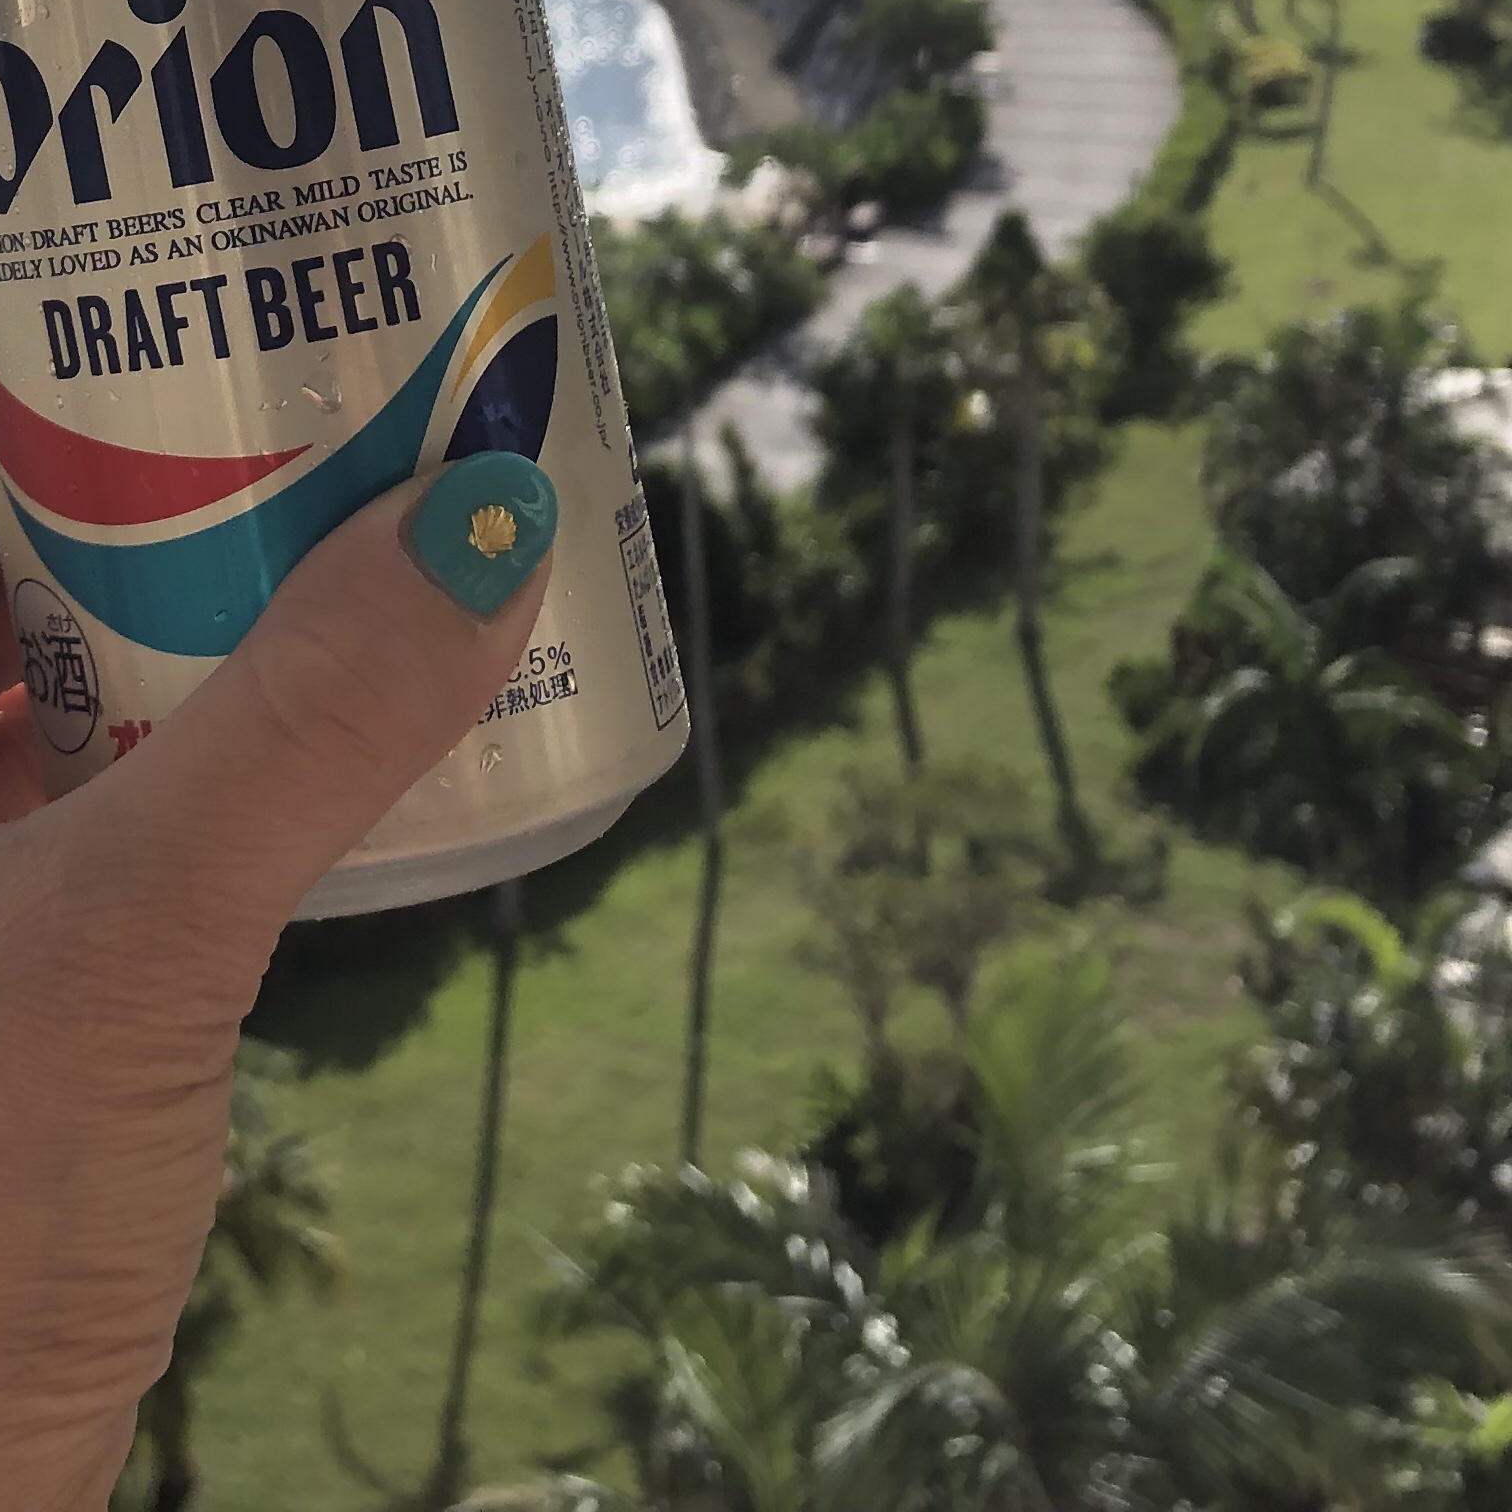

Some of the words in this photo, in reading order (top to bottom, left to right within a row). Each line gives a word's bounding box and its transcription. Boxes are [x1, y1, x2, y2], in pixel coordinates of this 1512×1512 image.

[31, 222, 98, 250] DRAFT
[108, 208, 186, 240] BEER'S
[196, 192, 284, 225] CLEAR
[295, 175, 361, 209] MILD
[369, 158, 442, 191] TASTE
[450, 151, 469, 172] IS
[50, 252, 122, 277] LOVED
[129, 243, 159, 267] AS
[168, 234, 204, 260] AN
[212, 205, 351, 251] OKINAWAN
[357, 181, 474, 224] ORIGINAL.
[41, 274, 231, 380] DRAFT
[245, 240, 422, 352] BEER
